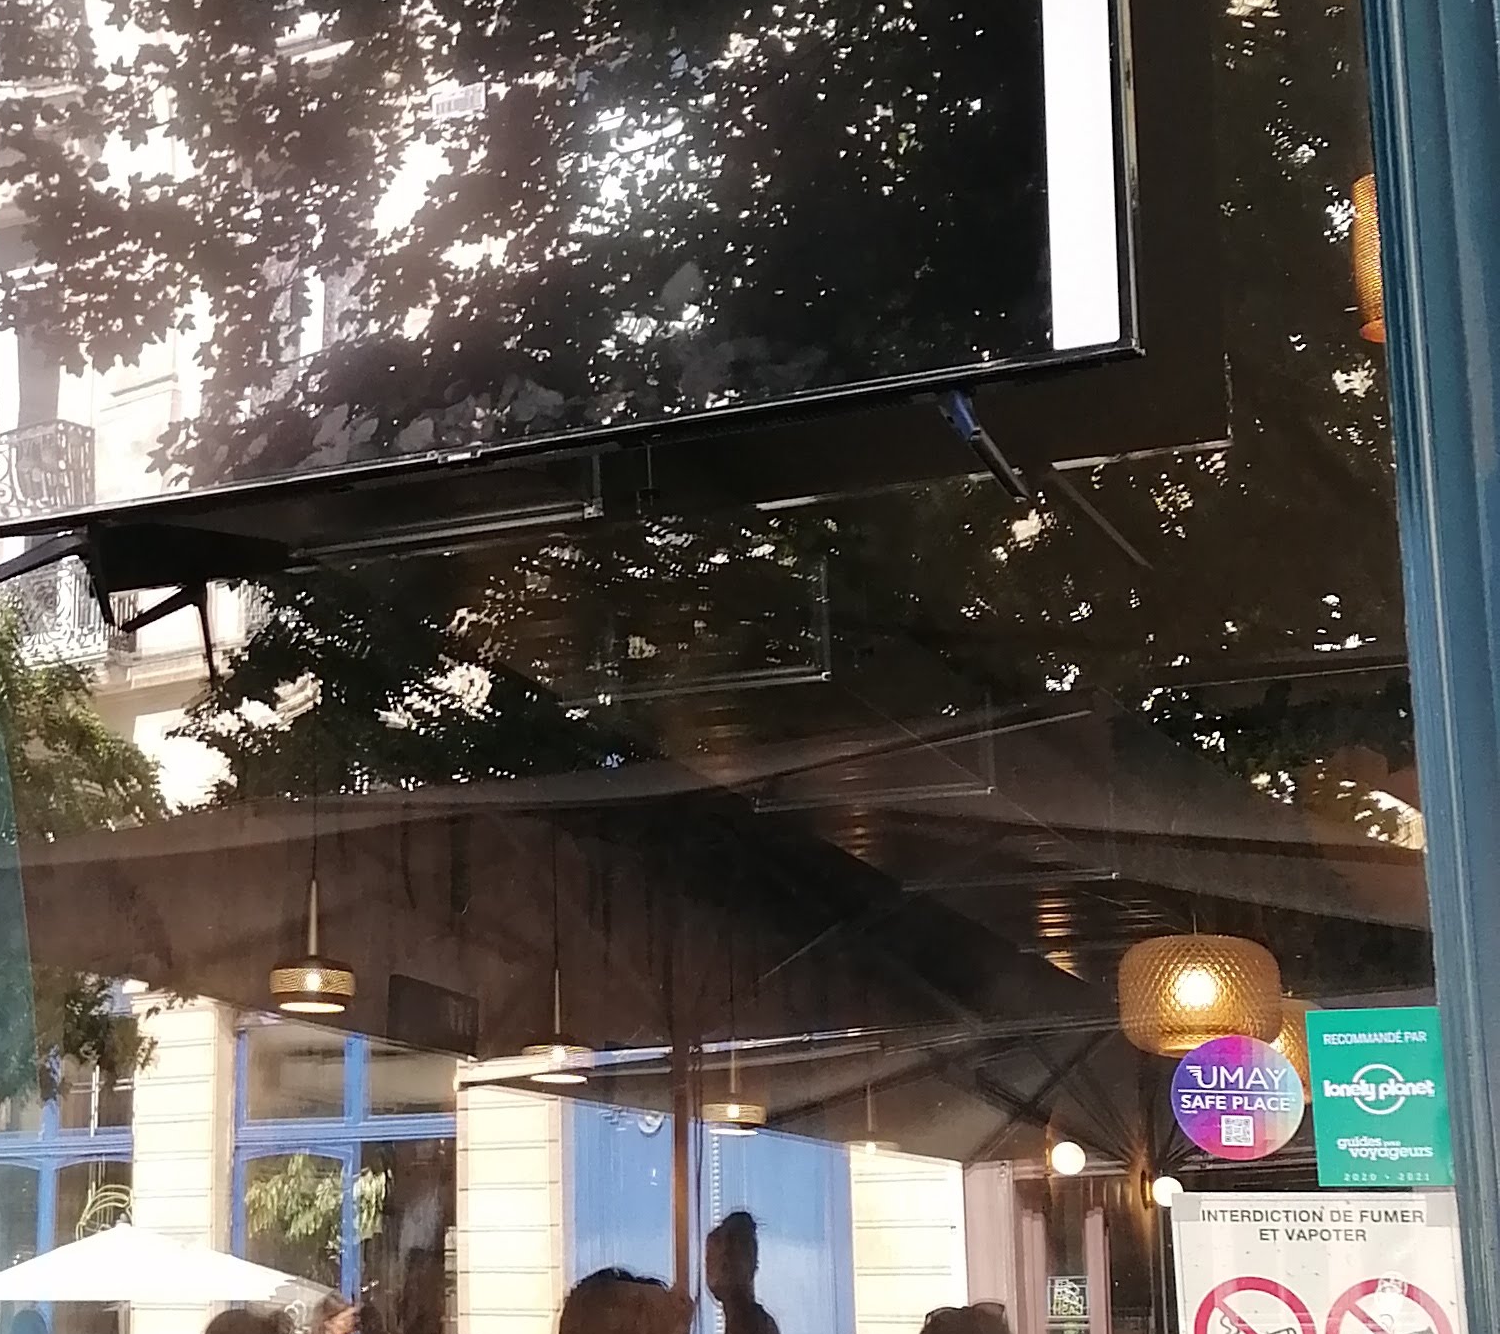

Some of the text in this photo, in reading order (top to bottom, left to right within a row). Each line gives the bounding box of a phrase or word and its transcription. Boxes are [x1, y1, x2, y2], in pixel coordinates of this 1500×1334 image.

[1322, 1031, 1428, 1045] RECOMMANDÉ PAR
[1195, 1064, 1288, 1090] UMAY
[1323, 1079, 1435, 1102] lonely planet
[1181, 1094, 1291, 1112] SAFE PLACE
[1337, 1135, 1383, 1150] guides
[1349, 1145, 1434, 1161] voyageurs
[1201, 1209, 1425, 1224] INTERDICTION DE FUMER
[1259, 1228, 1368, 1242] ET VAPOTER
